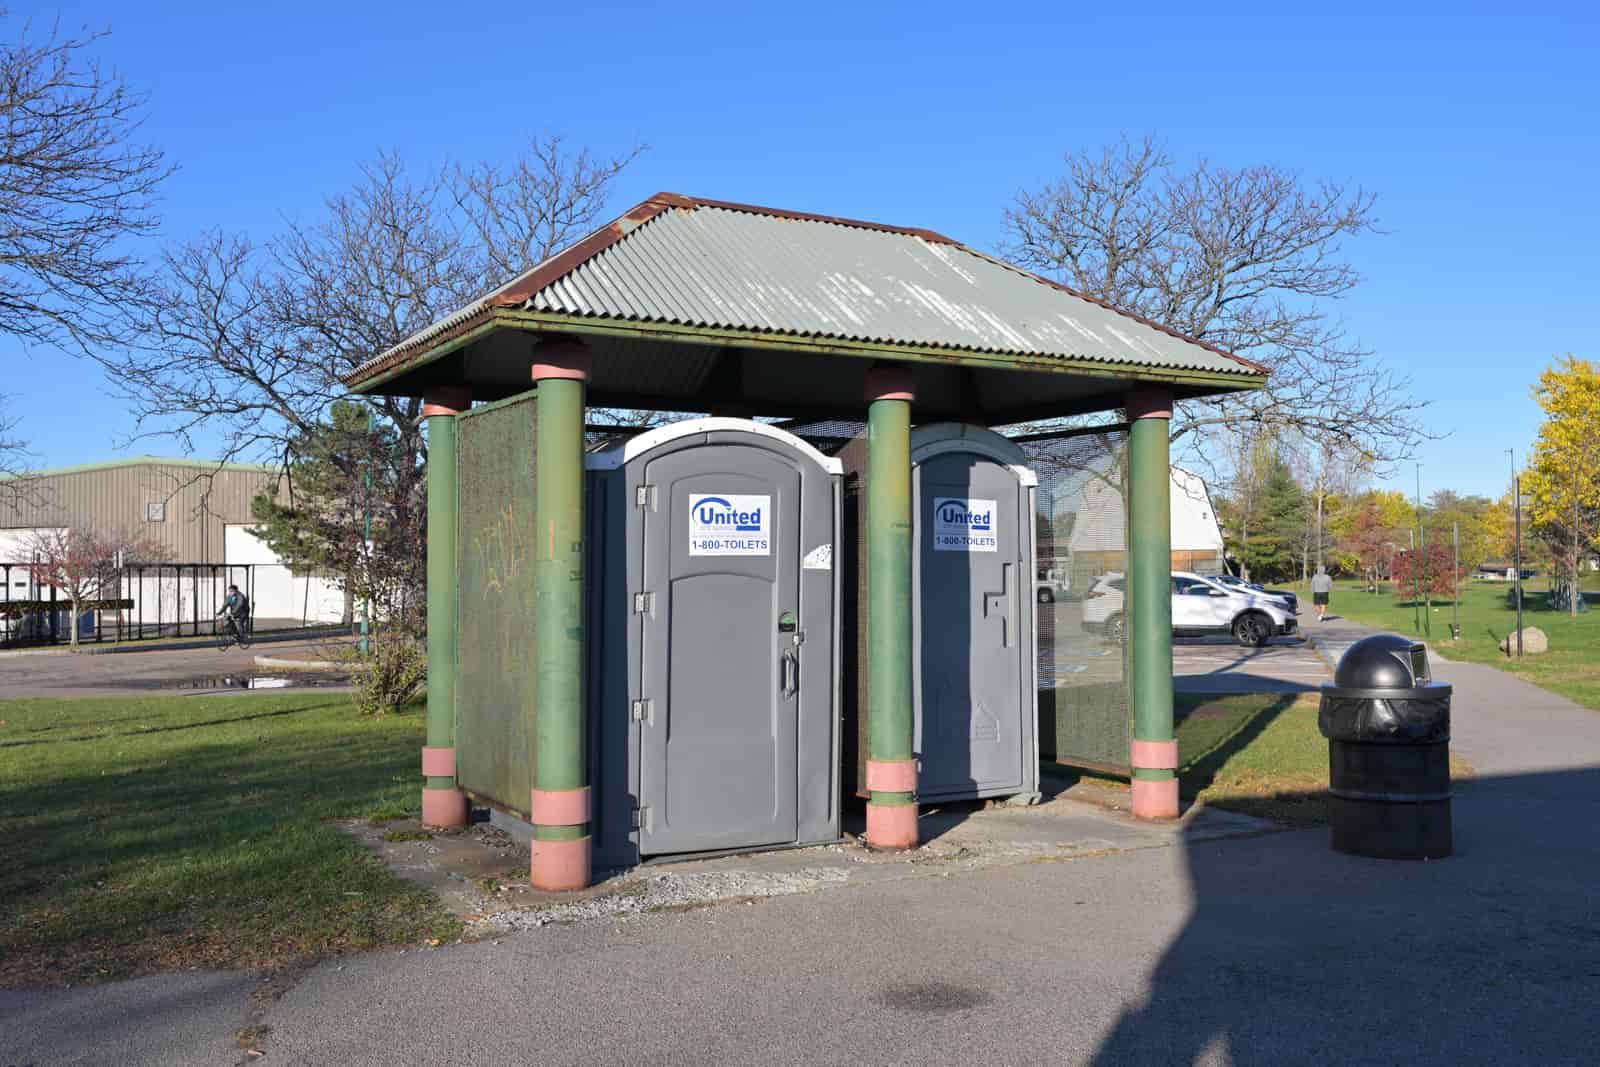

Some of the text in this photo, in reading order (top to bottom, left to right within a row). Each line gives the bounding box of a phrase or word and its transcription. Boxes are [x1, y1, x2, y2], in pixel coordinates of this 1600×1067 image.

[700, 507, 761, 525] United
[943, 508, 991, 524] United
[692, 540, 768, 550] 1-800-TOILETS
[936, 535, 996, 546] 1-800-TOILETS
